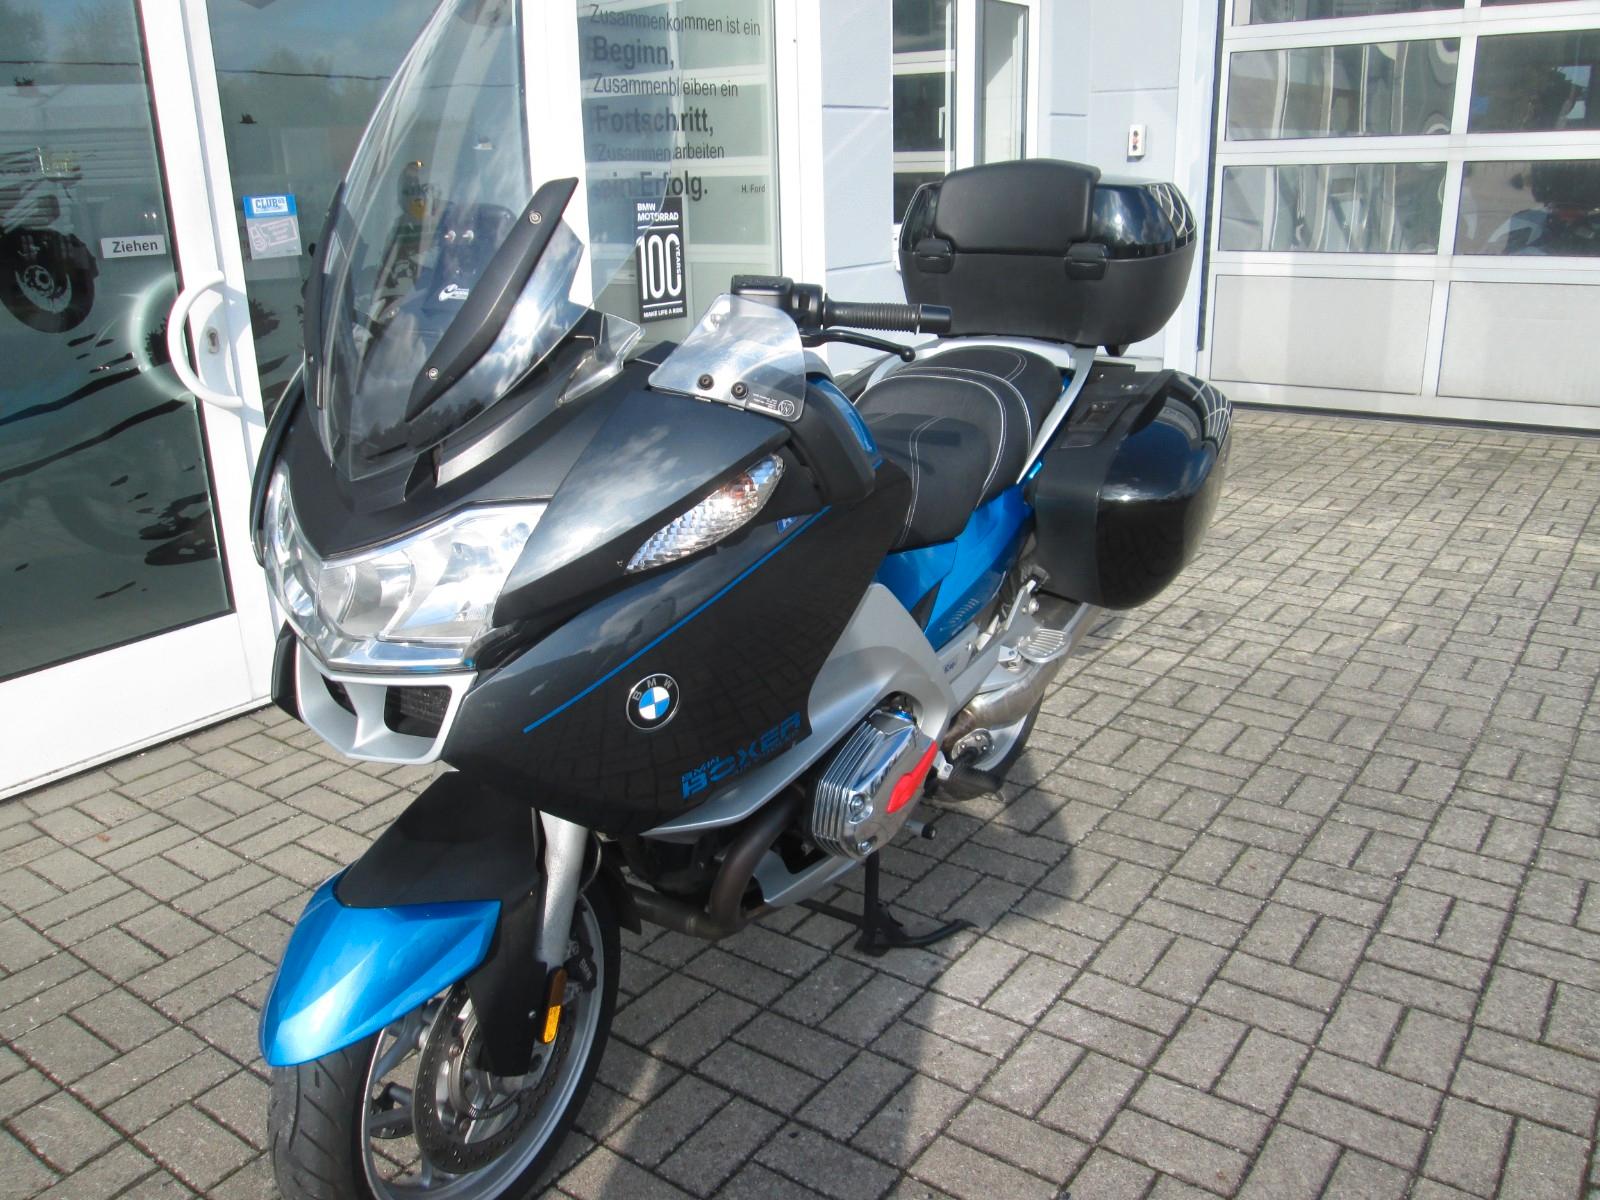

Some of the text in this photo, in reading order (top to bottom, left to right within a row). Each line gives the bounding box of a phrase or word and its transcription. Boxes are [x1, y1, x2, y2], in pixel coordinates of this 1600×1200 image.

[589, 4, 761, 36] Zusammenkommen ist ein
[592, 35, 674, 70] Beginn,
[592, 73, 738, 97] Zusammenbleiben ein
[593, 105, 714, 137] Fortschritt,
[639, 170, 708, 201] Erfolg.
[741, 184, 765, 193] H. Ford
[637, 203, 656, 212] BMW
[637, 212, 679, 222] MOTORRAD
[112, 240, 158, 253] Ziehen
[636, 233, 682, 300] 100
[633, 677, 673, 701] BMW
